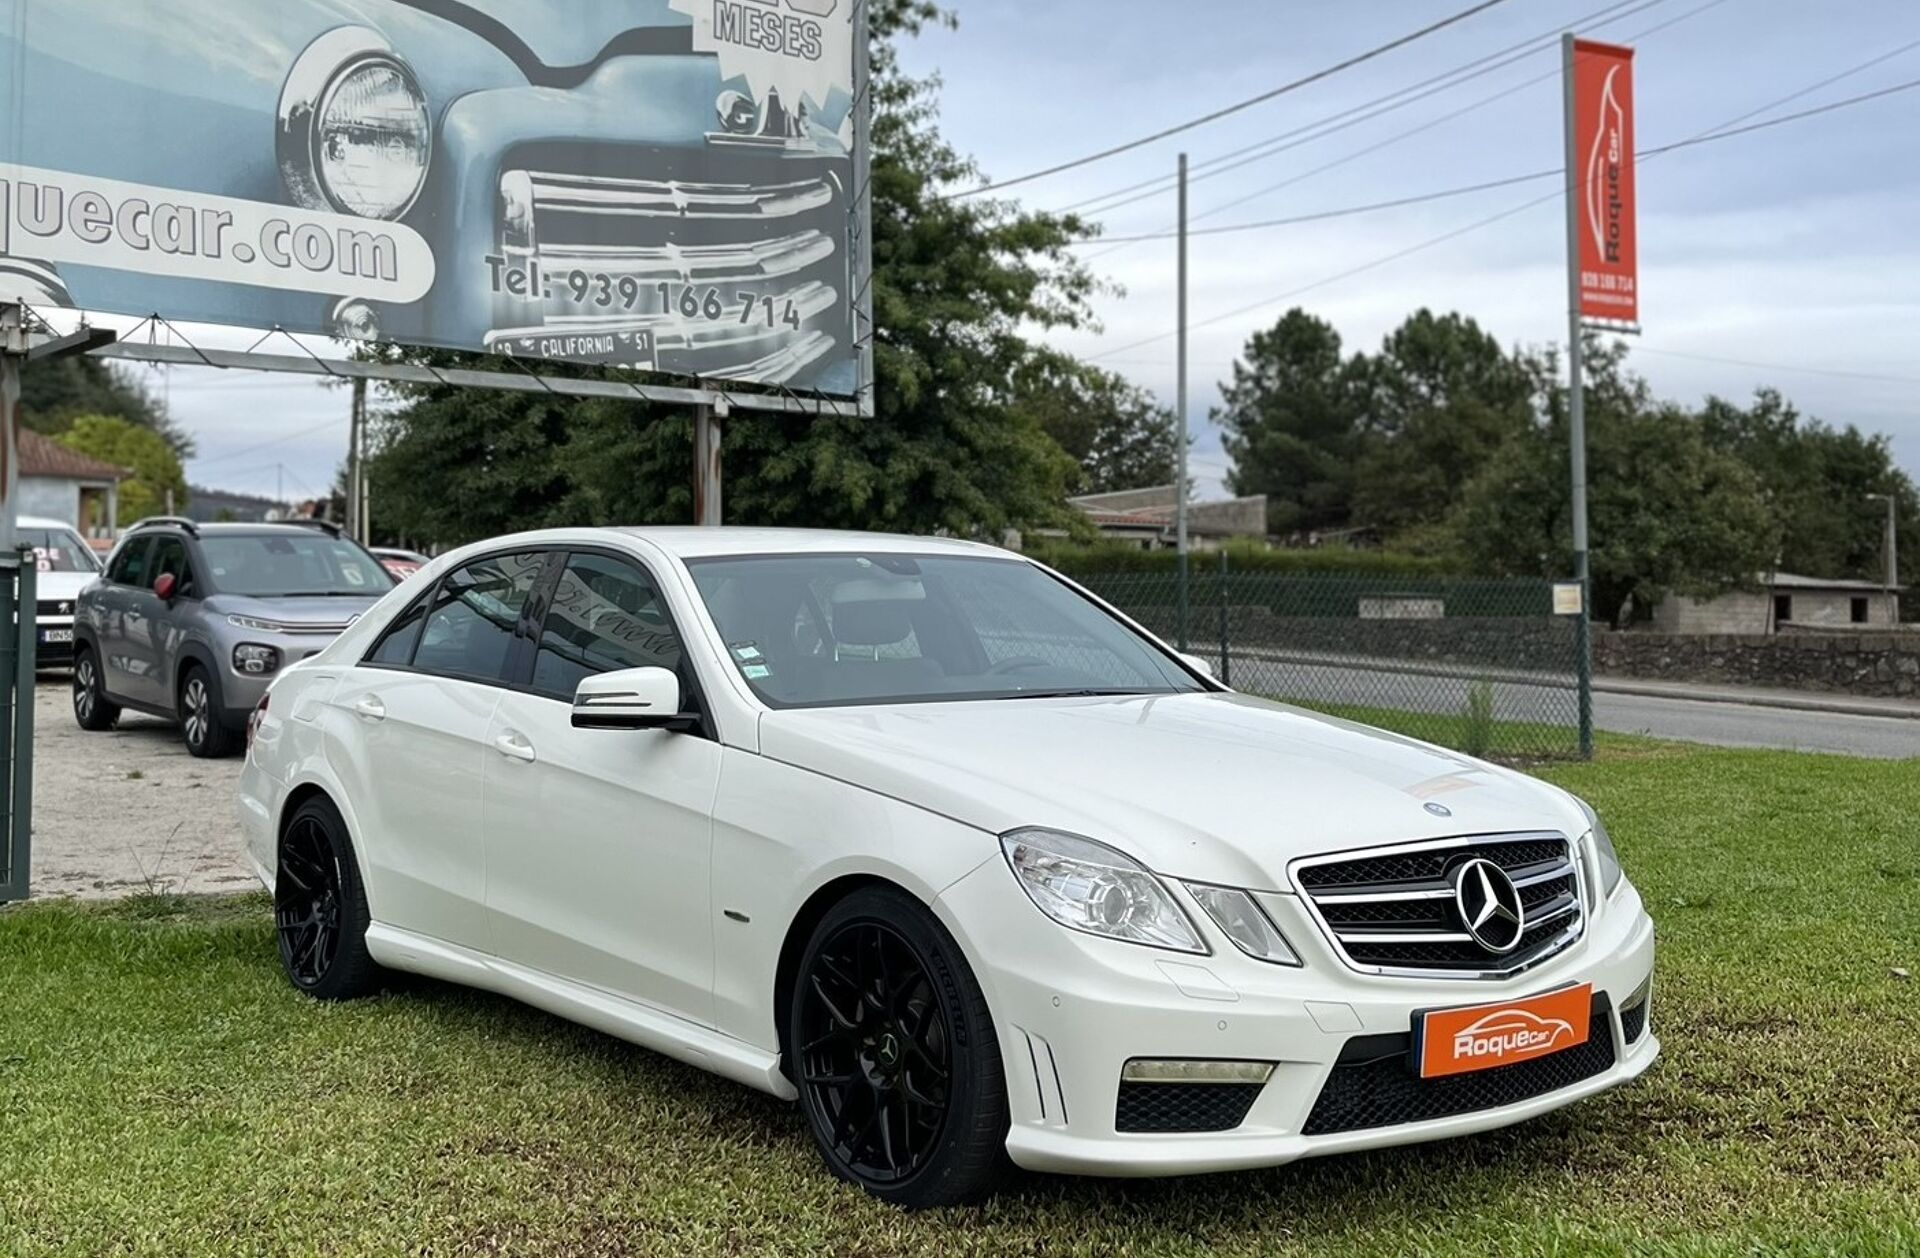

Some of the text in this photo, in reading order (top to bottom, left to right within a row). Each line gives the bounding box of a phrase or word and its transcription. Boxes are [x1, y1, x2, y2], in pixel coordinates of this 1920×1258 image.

[713, 0, 822, 61] MESES
[0, 178, 399, 283] uecar.com
[485, 255, 800, 331] Tel: 939 166 714
[541, 335, 614, 358] CALIFORNIA
[635, 332, 648, 350] 51
